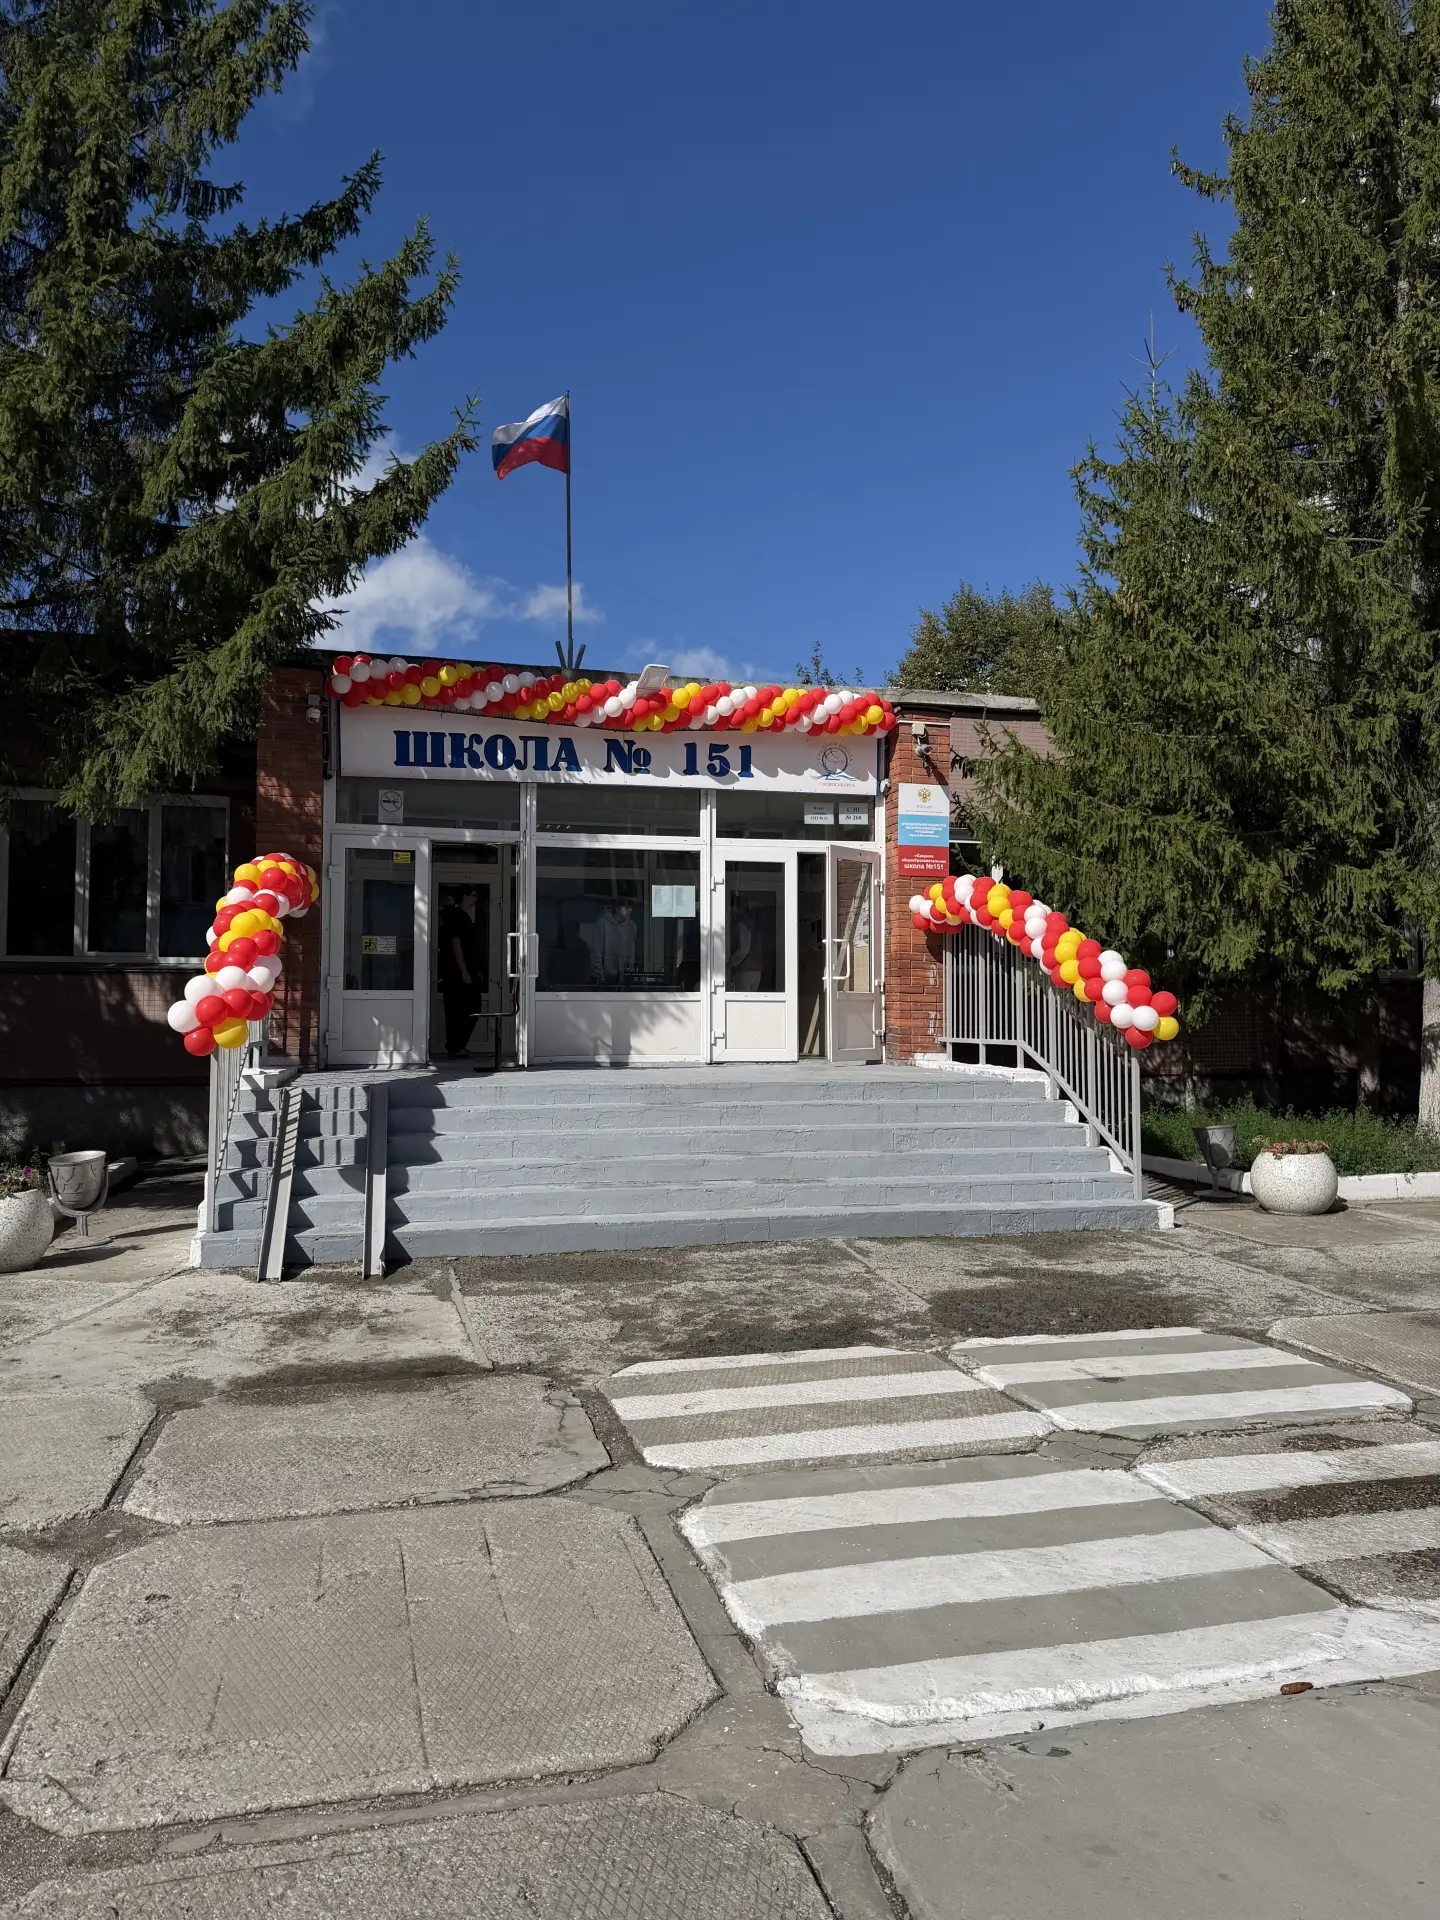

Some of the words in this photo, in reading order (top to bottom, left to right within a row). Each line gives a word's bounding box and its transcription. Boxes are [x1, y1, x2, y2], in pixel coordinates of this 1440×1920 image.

[393, 730, 583, 773] ШКОЛА
[603, 738, 652, 774] №
[682, 742, 754, 778] 151
